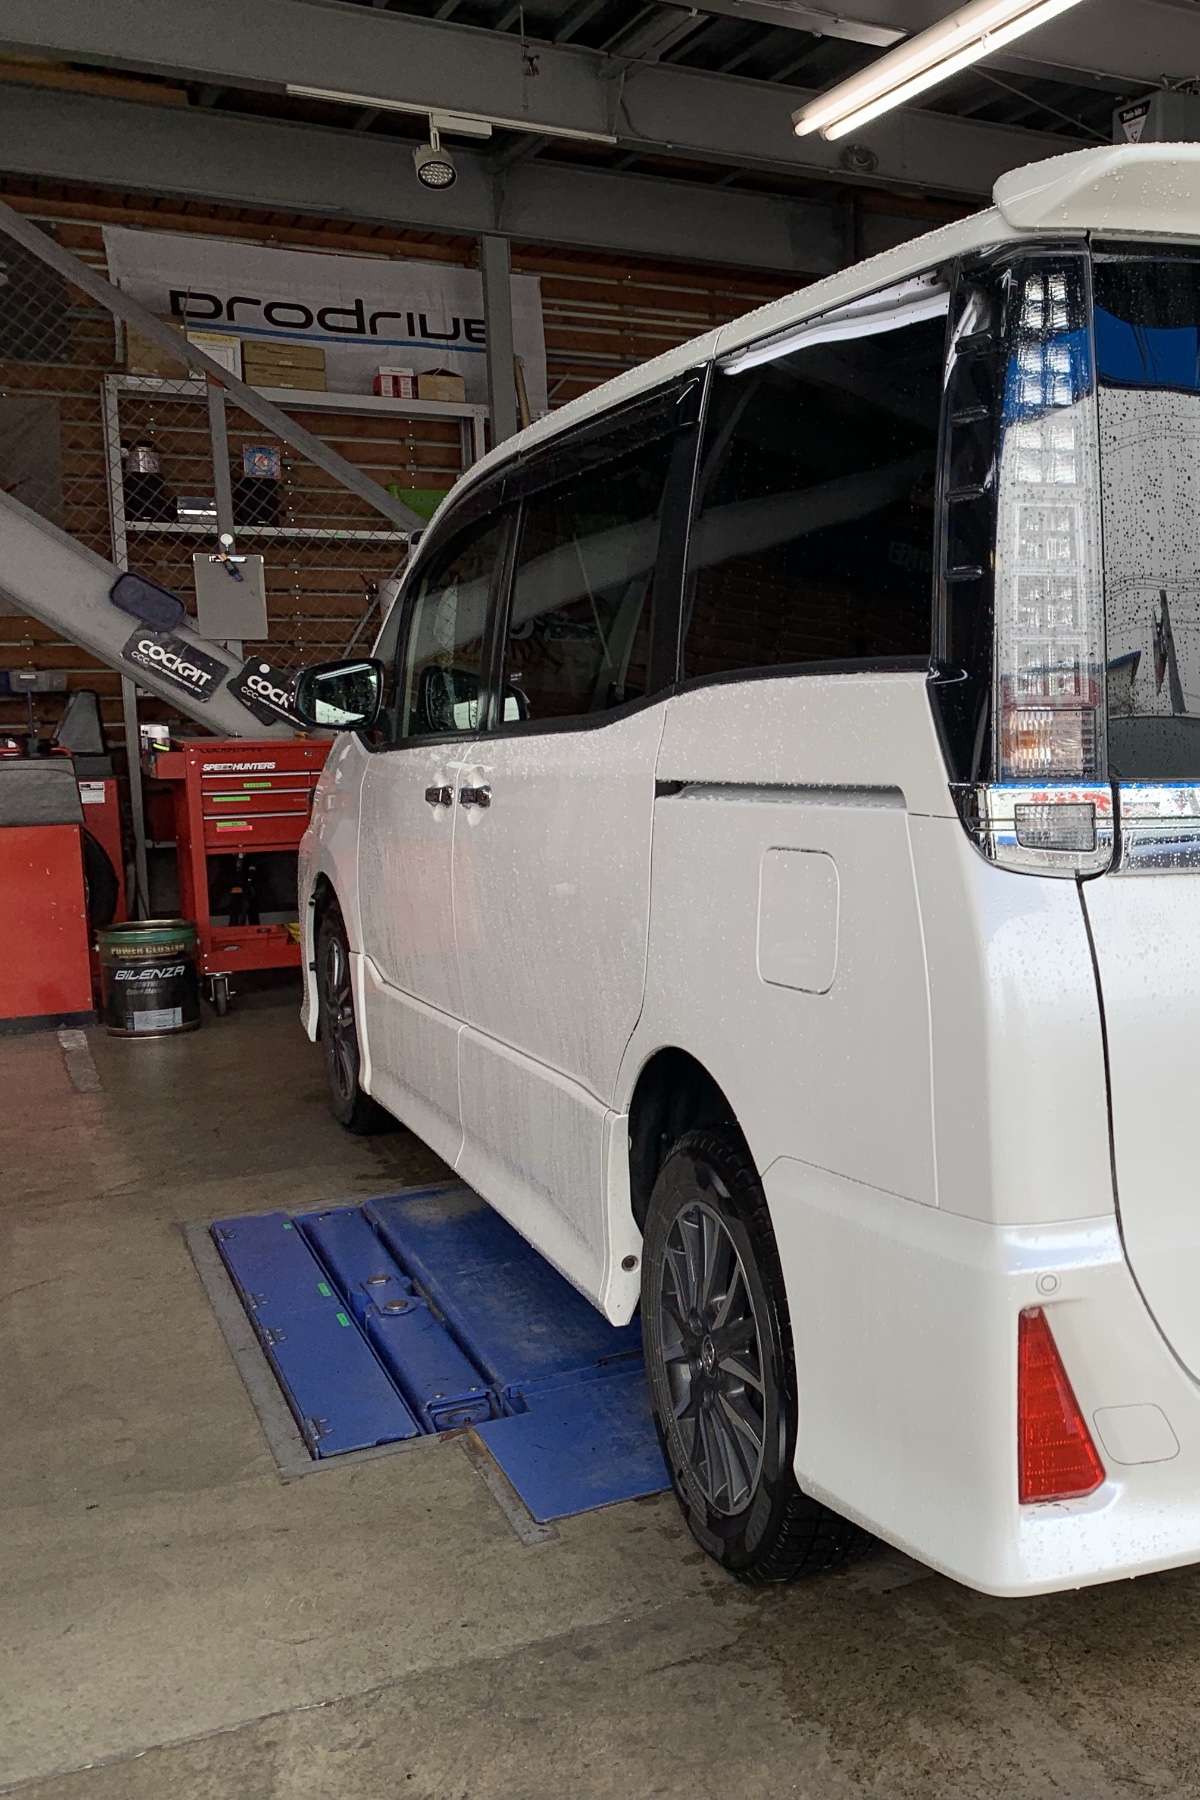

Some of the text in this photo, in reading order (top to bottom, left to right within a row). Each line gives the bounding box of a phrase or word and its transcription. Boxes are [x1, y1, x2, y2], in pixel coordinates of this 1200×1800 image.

[138, 639, 212, 686] COCKPIT
[247, 675, 289, 709] COCK
[202, 761, 276, 771] SPEEDHUNTERS
